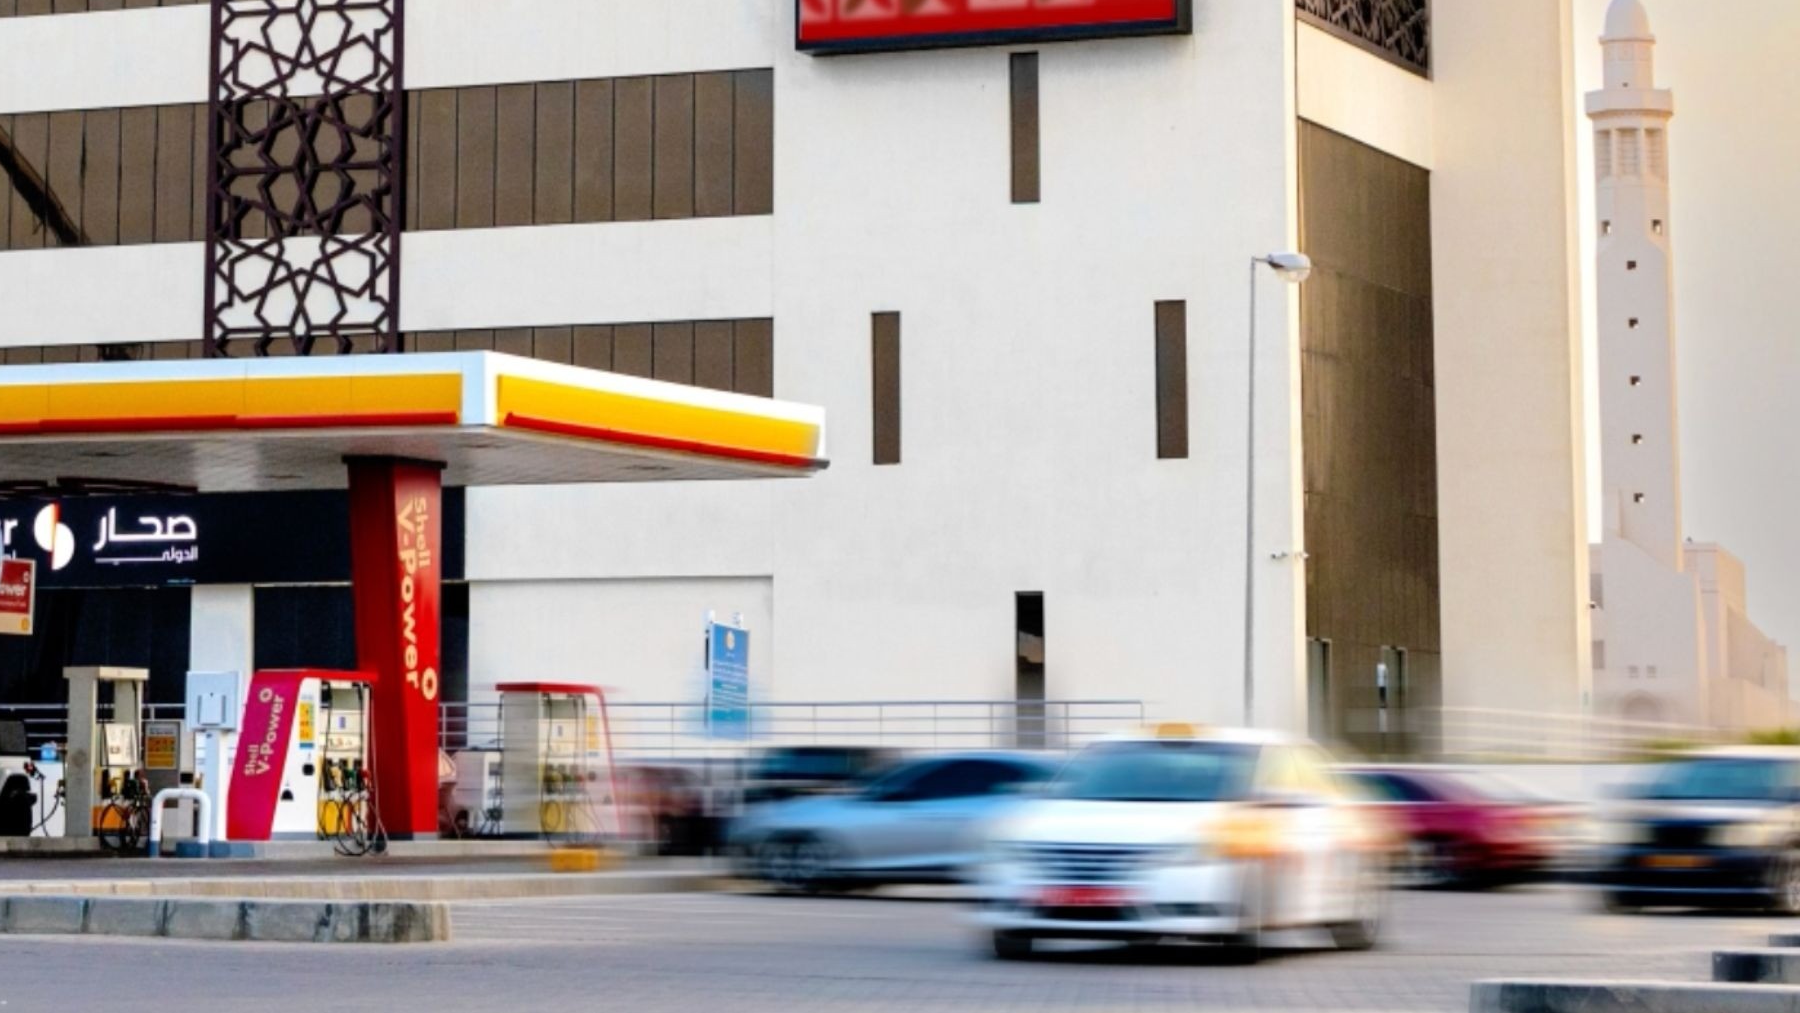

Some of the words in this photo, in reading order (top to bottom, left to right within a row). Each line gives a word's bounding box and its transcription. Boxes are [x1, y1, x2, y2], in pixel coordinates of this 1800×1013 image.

[93, 506, 198, 551] صحار
[415, 496, 432, 569] Shell
[397, 499, 420, 690] V-Power
[243, 744, 260, 776] Shell
[255, 694, 285, 776] V-Power
